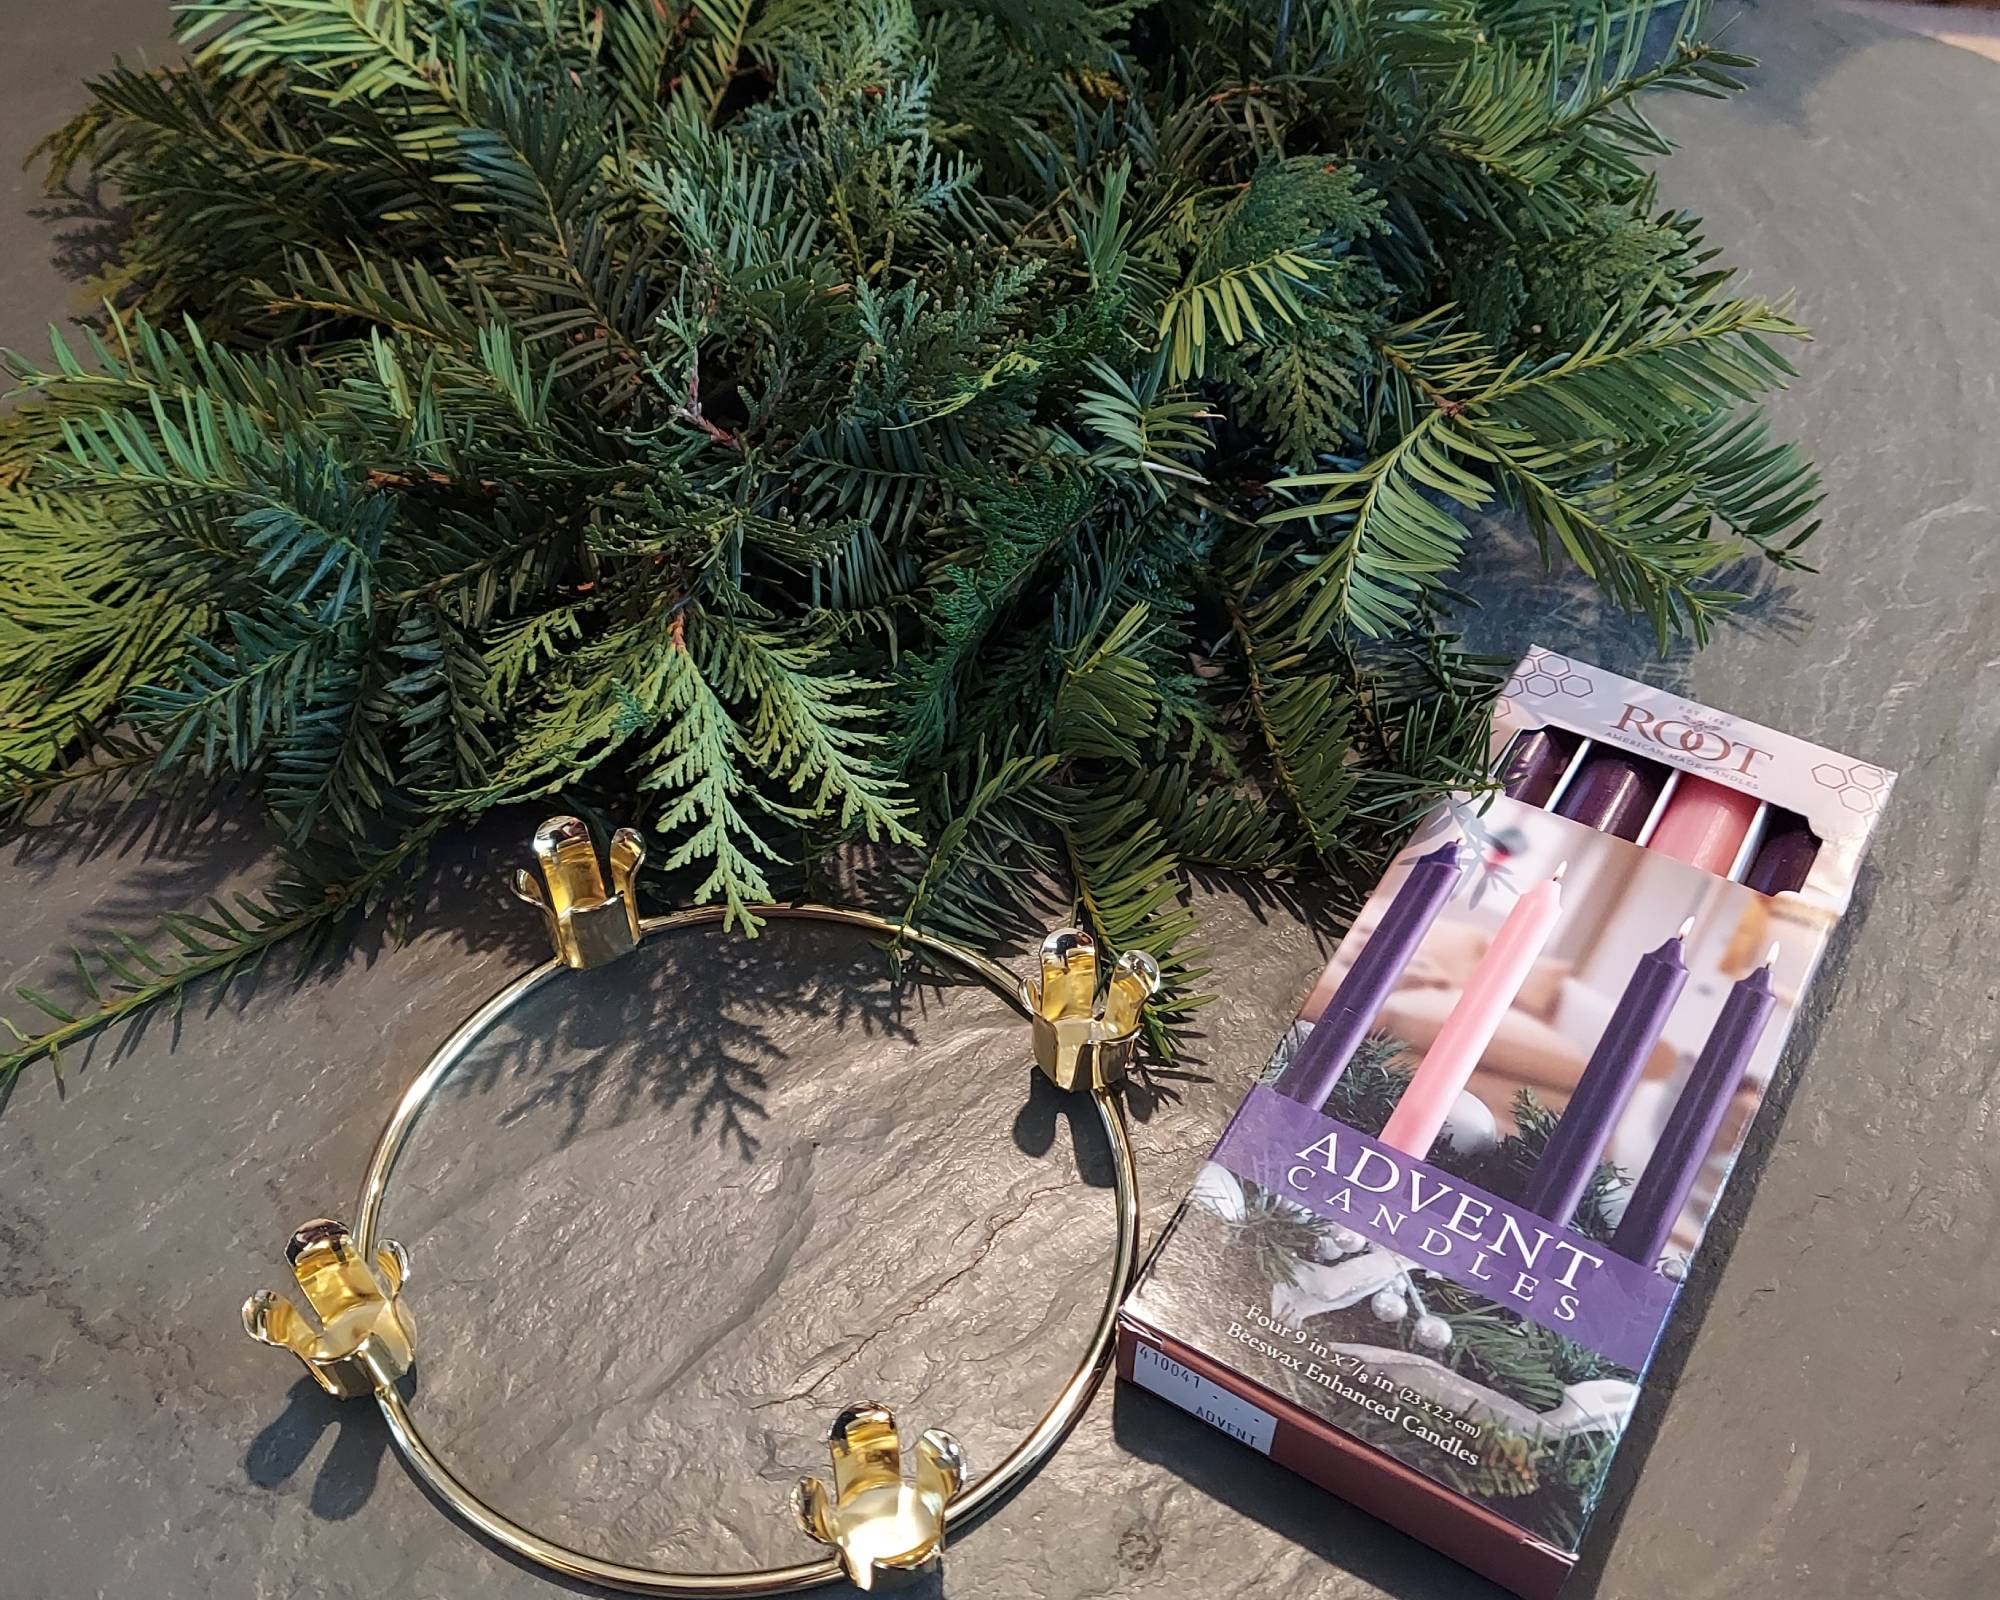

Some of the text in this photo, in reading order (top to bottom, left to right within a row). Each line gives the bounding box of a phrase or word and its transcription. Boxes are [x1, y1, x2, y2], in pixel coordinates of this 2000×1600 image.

[1604, 732, 1760, 790] AMERICAN MADE CANDLES
[1608, 703, 1774, 777] ROOT
[1287, 1166, 1581, 1322] CANDLES
[1295, 1132, 1604, 1292] ADVENT
[1139, 1346, 1200, 1389] 410041
[1226, 1321, 1479, 1466] Beeswax Enhanced Candles
[1245, 1306, 1292, 1338] Four
[1292, 1330, 1307, 1344] 9
[1308, 1338, 1328, 1358] in
[1330, 1353, 1346, 1367] x
[1372, 1371, 1395, 1394] in
[1400, 1387, 1422, 1405] (23
[1421, 1401, 1432, 1412] x
[1432, 1405, 1454, 1423] 2.2
[1455, 1420, 1481, 1439] cm)
[1195, 1406, 1257, 1446] ADVENT
